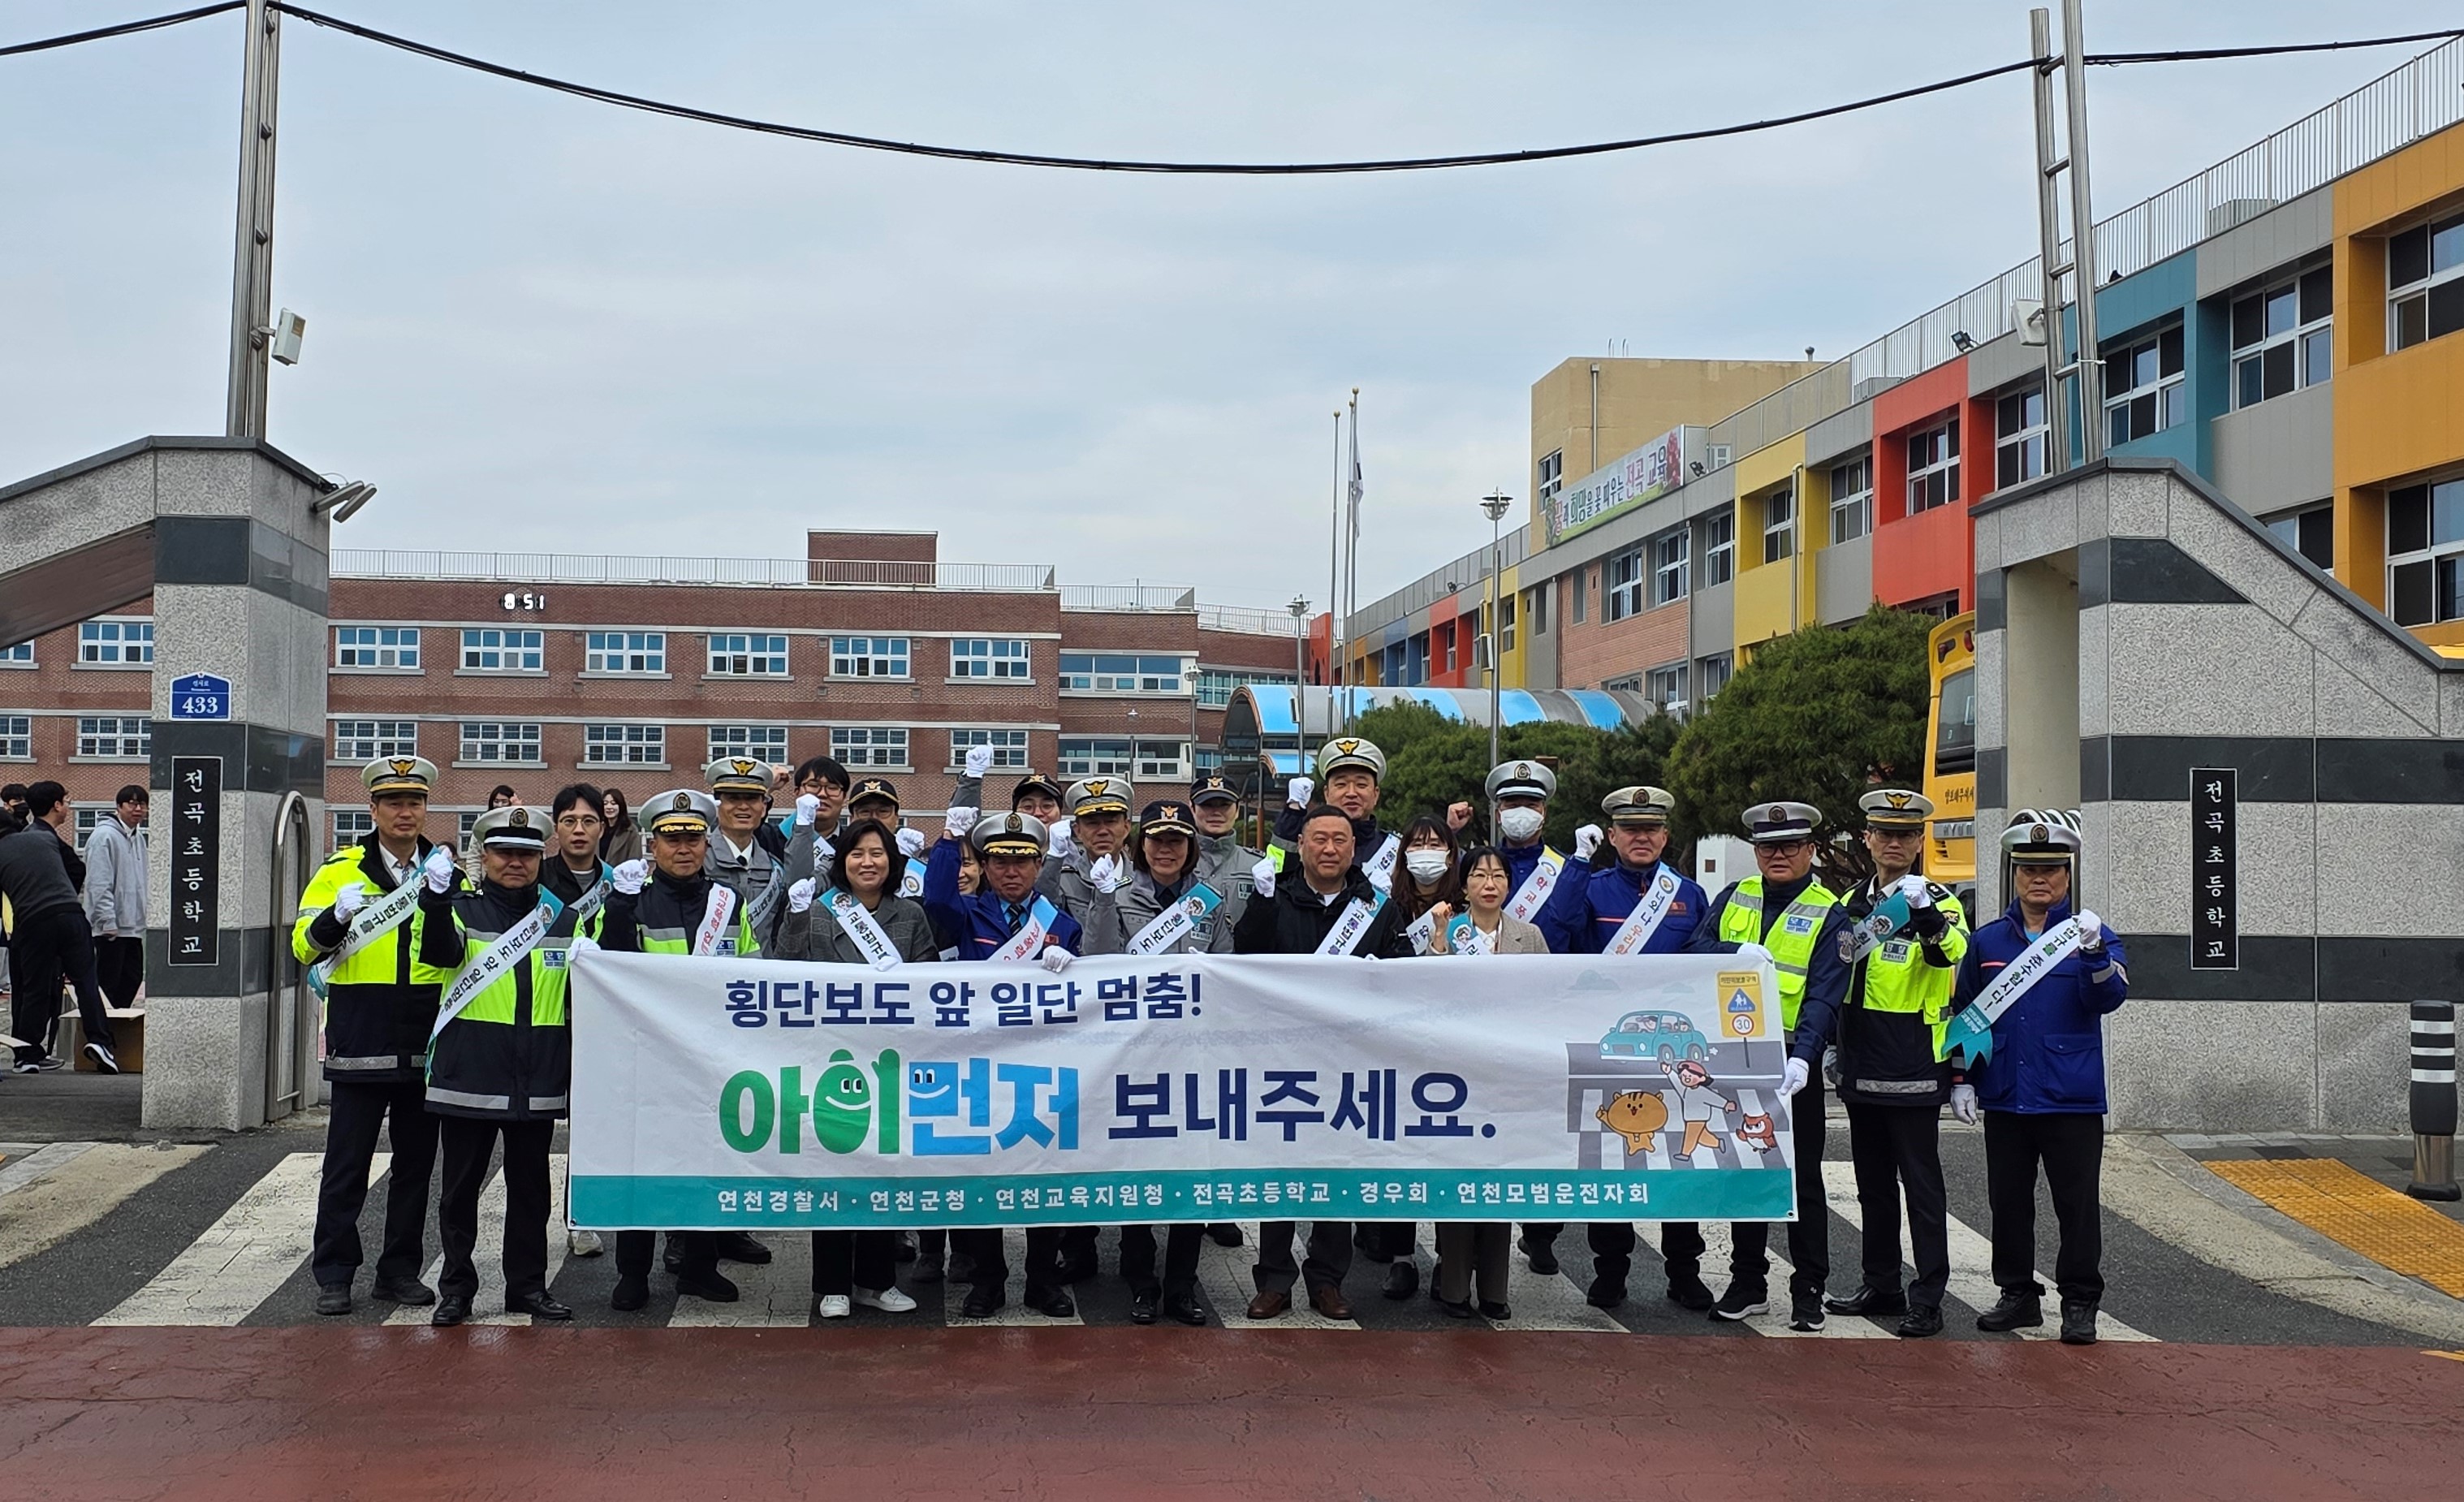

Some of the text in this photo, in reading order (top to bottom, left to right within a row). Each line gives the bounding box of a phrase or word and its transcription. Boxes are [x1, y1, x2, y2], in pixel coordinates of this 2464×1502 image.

[1625, 457, 1645, 500] 전곡
[1647, 446, 1668, 487] 교육
[182, 697, 218, 714] 433
[182, 770, 205, 954] 전곡초등학교
[2204, 780, 2226, 958] 전곡초등학교
[725, 972, 1202, 1028] 횡단보도 앞 일단 멈춤!
[1736, 1019, 1750, 1029] 30
[719, 1048, 1497, 1157] 아이먼저 보내주세요.
[718, 1182, 1648, 1212] 연천경찰서 연천군청 연천교육지원청 전곡초등학교 경우회 연천모범운전자회
